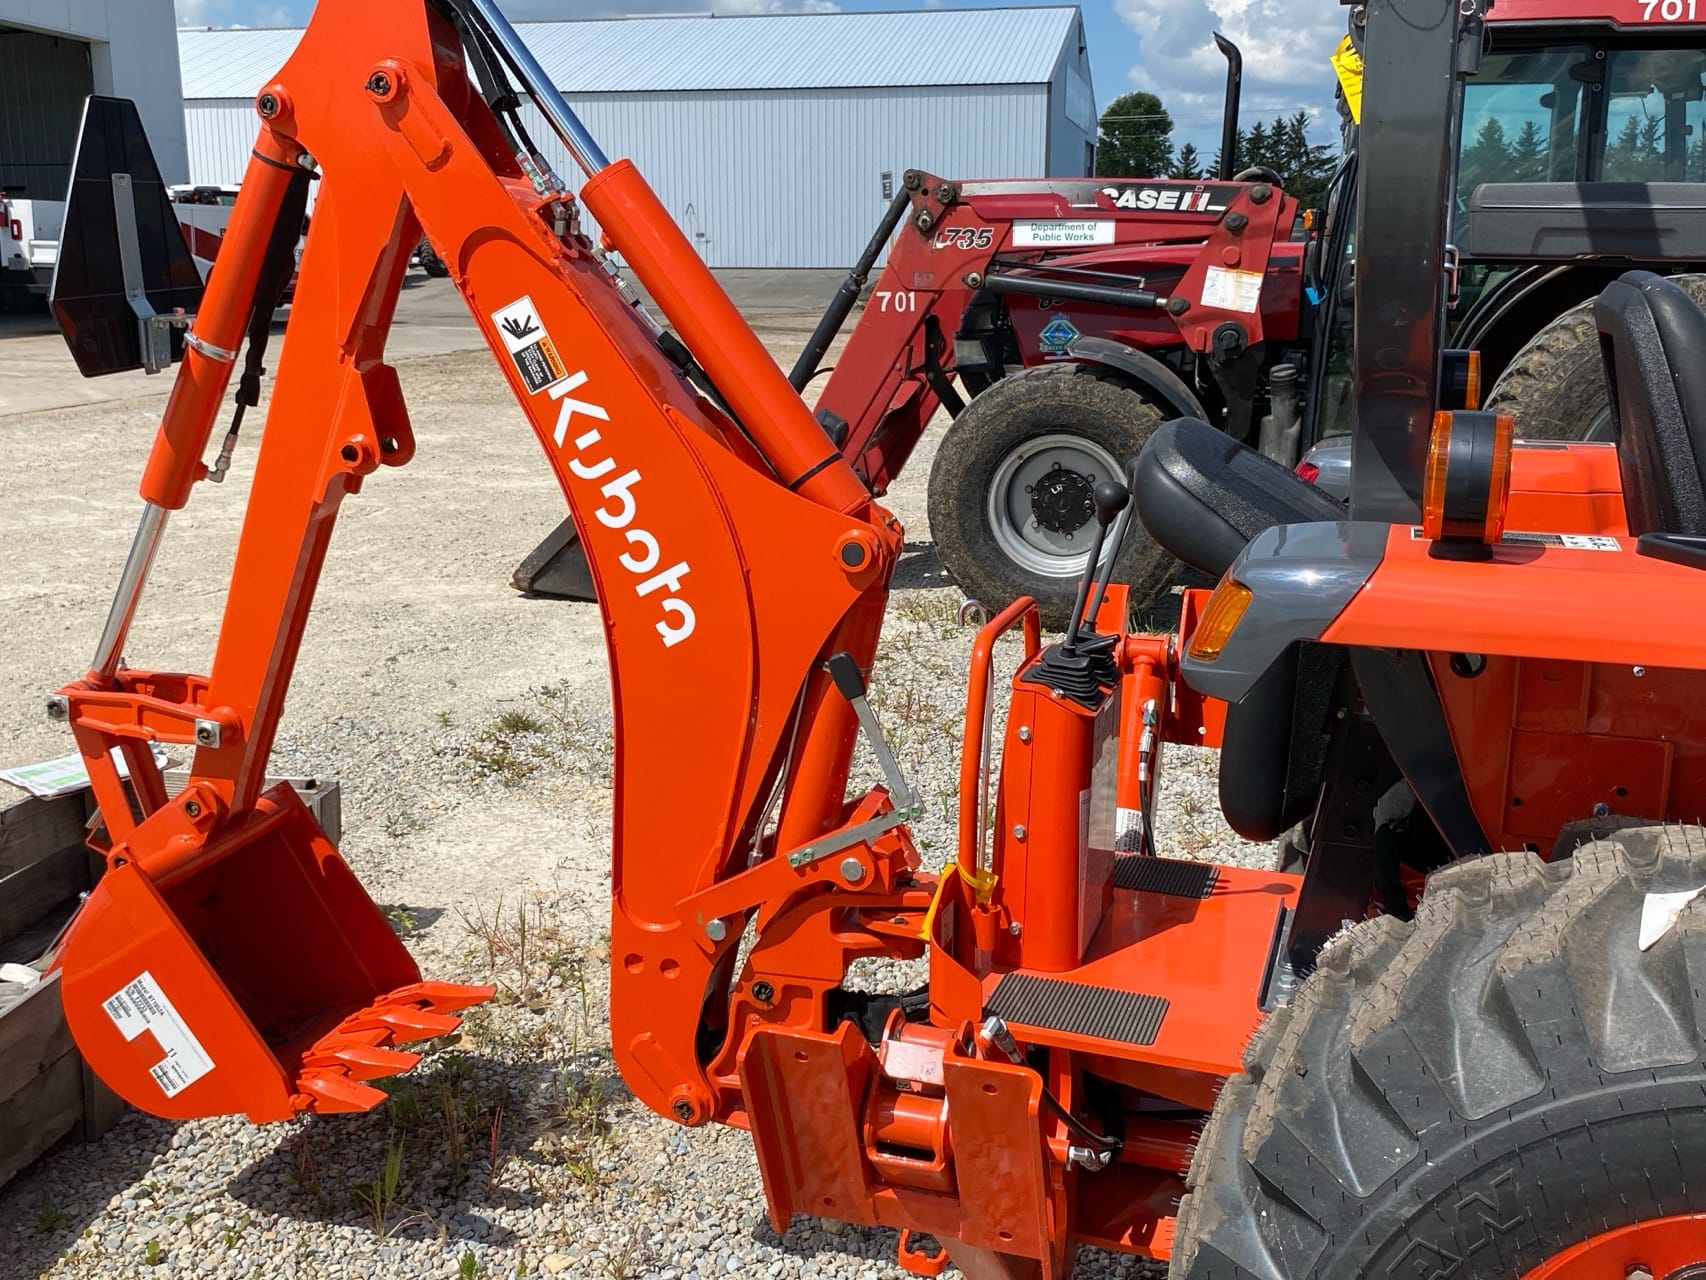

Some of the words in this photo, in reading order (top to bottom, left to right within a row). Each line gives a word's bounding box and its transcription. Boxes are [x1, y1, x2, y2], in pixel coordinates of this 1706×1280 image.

[1638, 0, 1697, 21] 701
[1100, 187, 1180, 210] CASE
[1031, 223, 1086, 232] Department
[1087, 222, 1097, 231] of
[1032, 233, 1062, 241] Public
[1064, 232, 1095, 241] Works
[876, 291, 916, 312] 701
[545, 346, 562, 375] WARNING
[547, 370, 697, 648] Kubota
